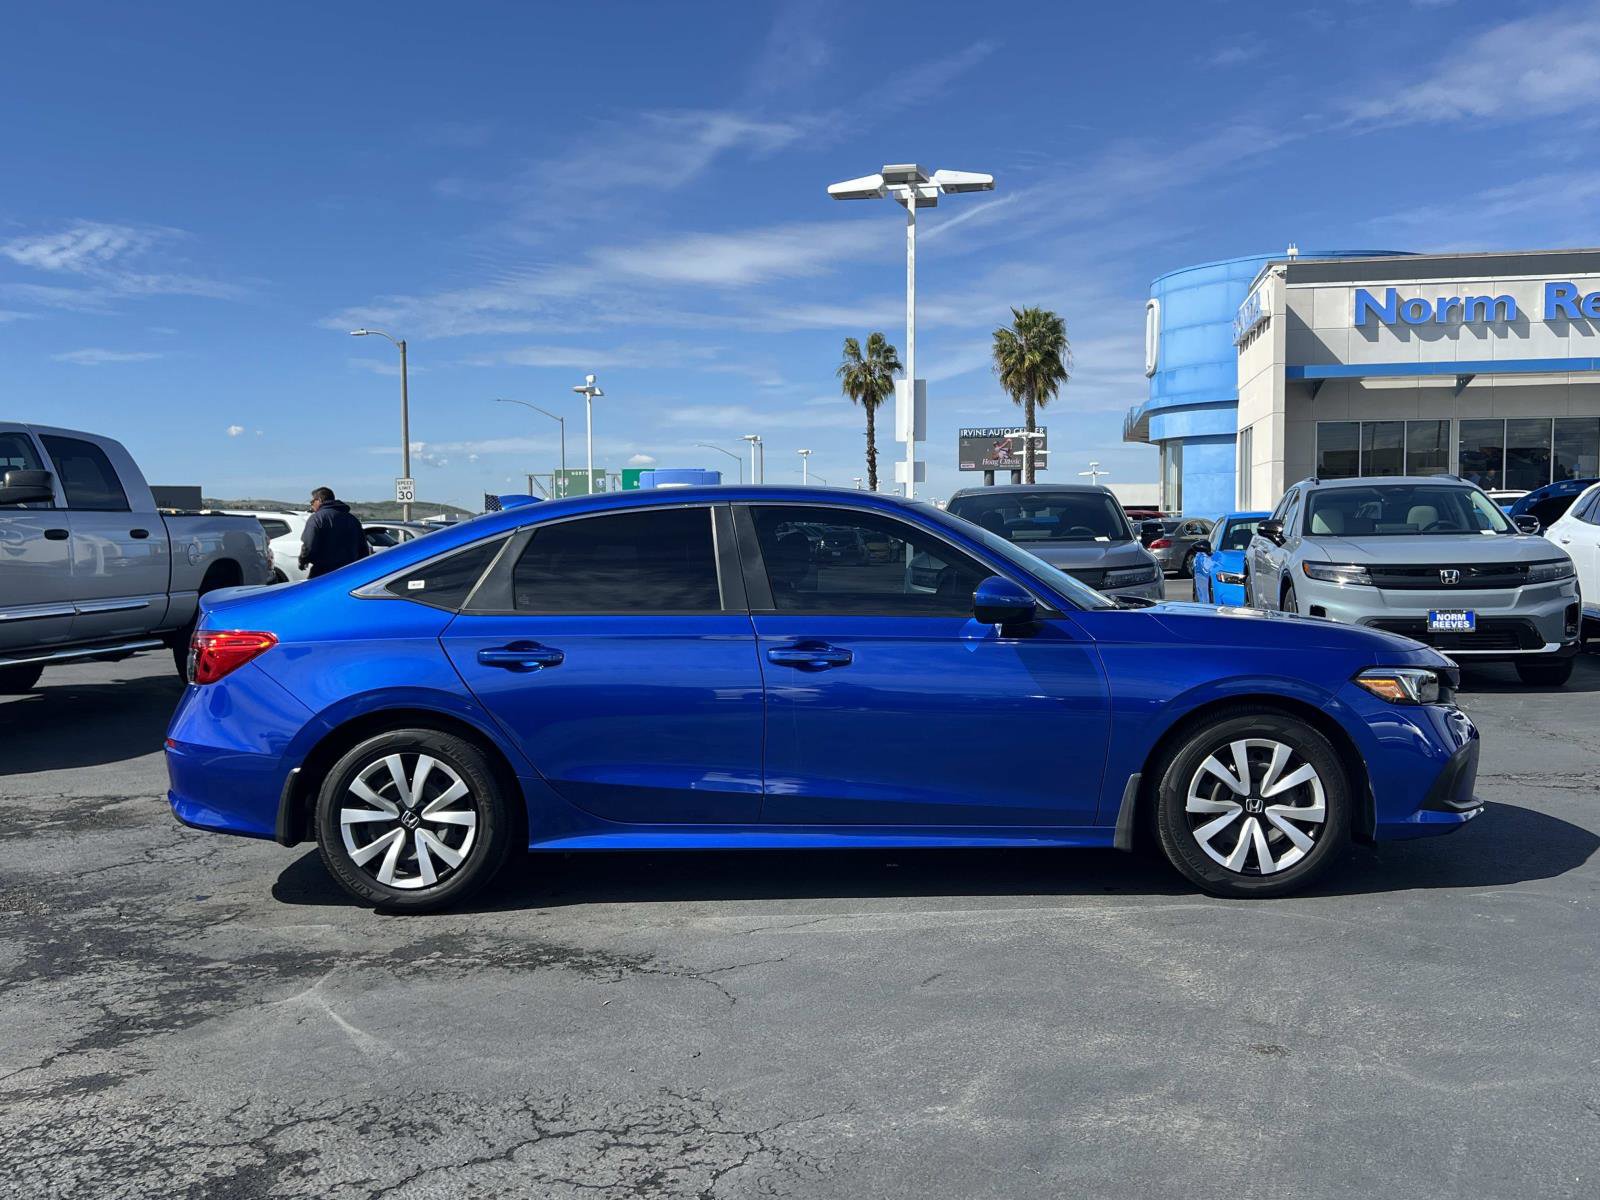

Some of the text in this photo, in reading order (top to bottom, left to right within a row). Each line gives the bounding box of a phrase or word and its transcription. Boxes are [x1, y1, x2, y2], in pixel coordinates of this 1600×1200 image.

[1355, 287, 1517, 326] Norm
[960, 428, 987, 437] IRVINE
[988, 428, 1011, 437] AUTO
[398, 491, 413, 500] 30
[1432, 620, 1470, 628] REEVES
